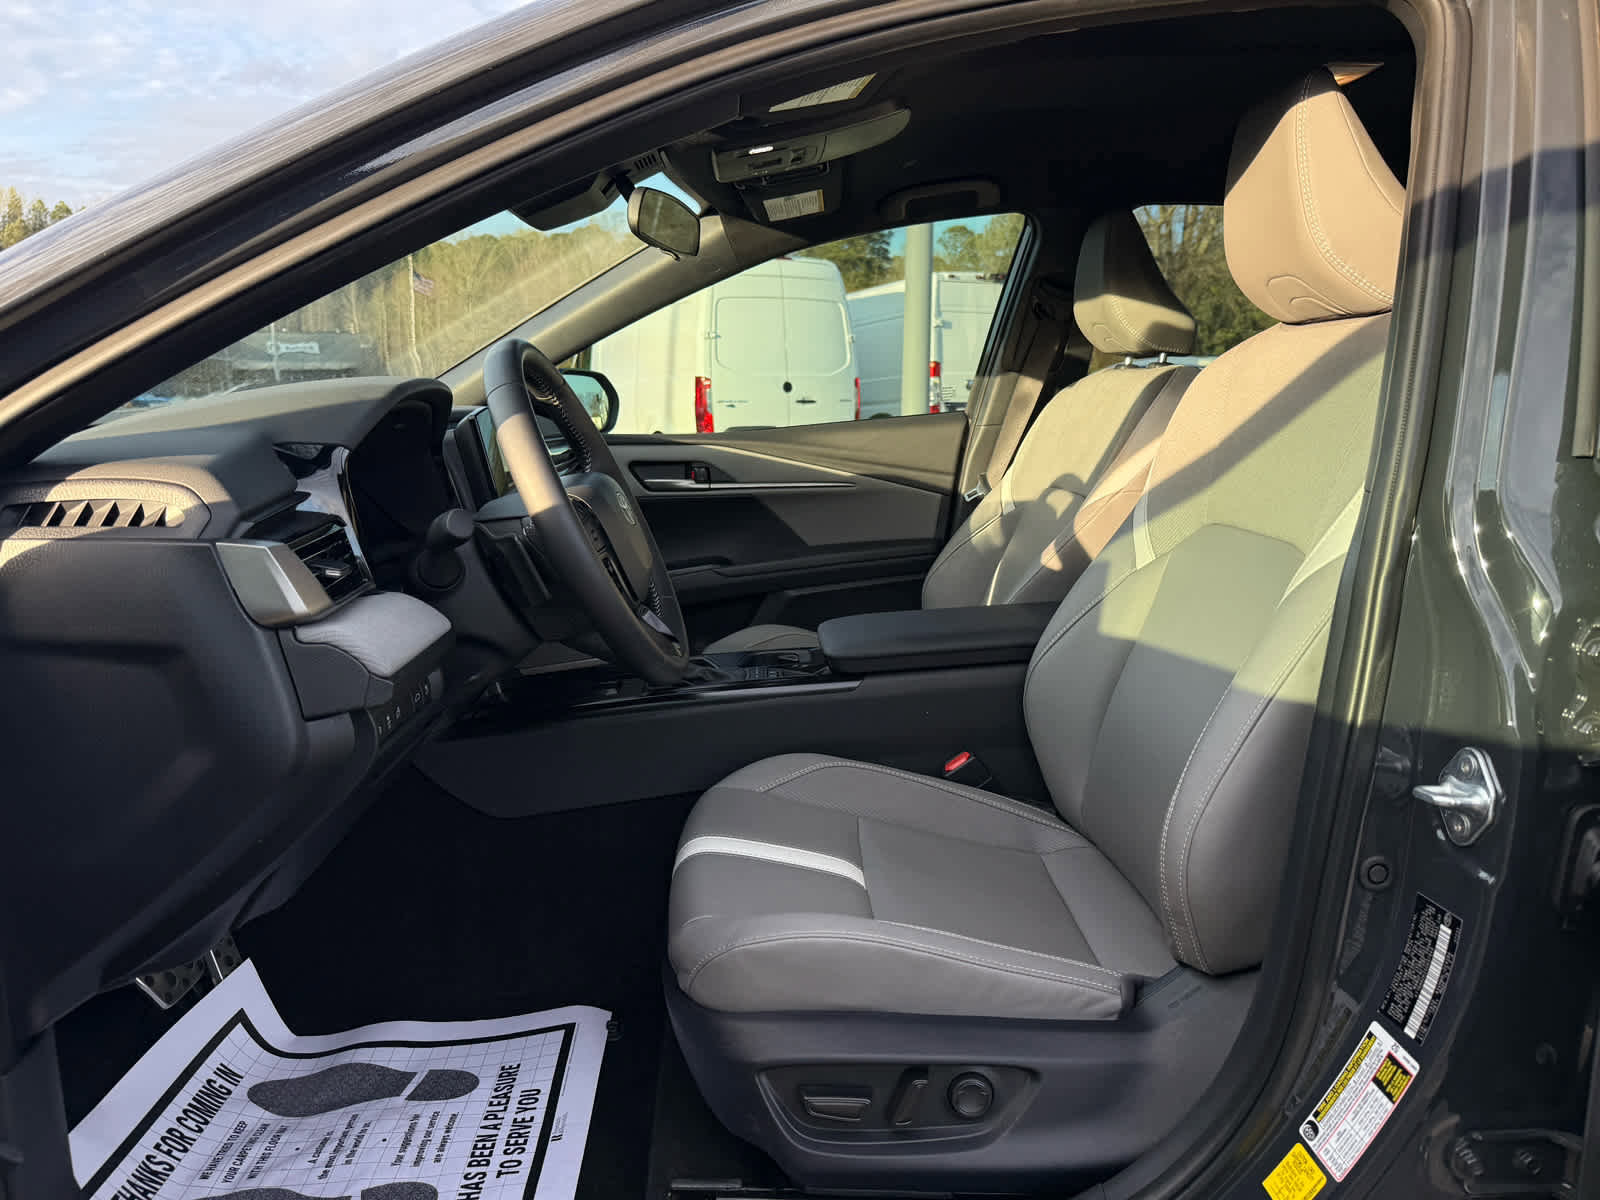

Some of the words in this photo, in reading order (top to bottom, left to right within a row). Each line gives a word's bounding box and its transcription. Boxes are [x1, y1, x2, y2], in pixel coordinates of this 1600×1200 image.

[483, 1063, 521, 1121] PLEASURE
[515, 1088, 541, 1115] YOU
[153, 1127, 197, 1161] FOR
[176, 1078, 232, 1134] COMING
[213, 1062, 244, 1087] IN
[232, 1120, 248, 1134] KEEP
[480, 1122, 503, 1132] A
[503, 1115, 535, 1156] SERVE
[226, 1134, 240, 1142] TO
[264, 1134, 282, 1151] FLOOR
[256, 1152, 273, 1165] THIS
[467, 1133, 500, 1169] BEEN
[222, 1166, 240, 1183] YOUR
[247, 1165, 264, 1179] WITH
[496, 1159, 523, 1179] TO
[456, 1172, 487, 1200] HAS
